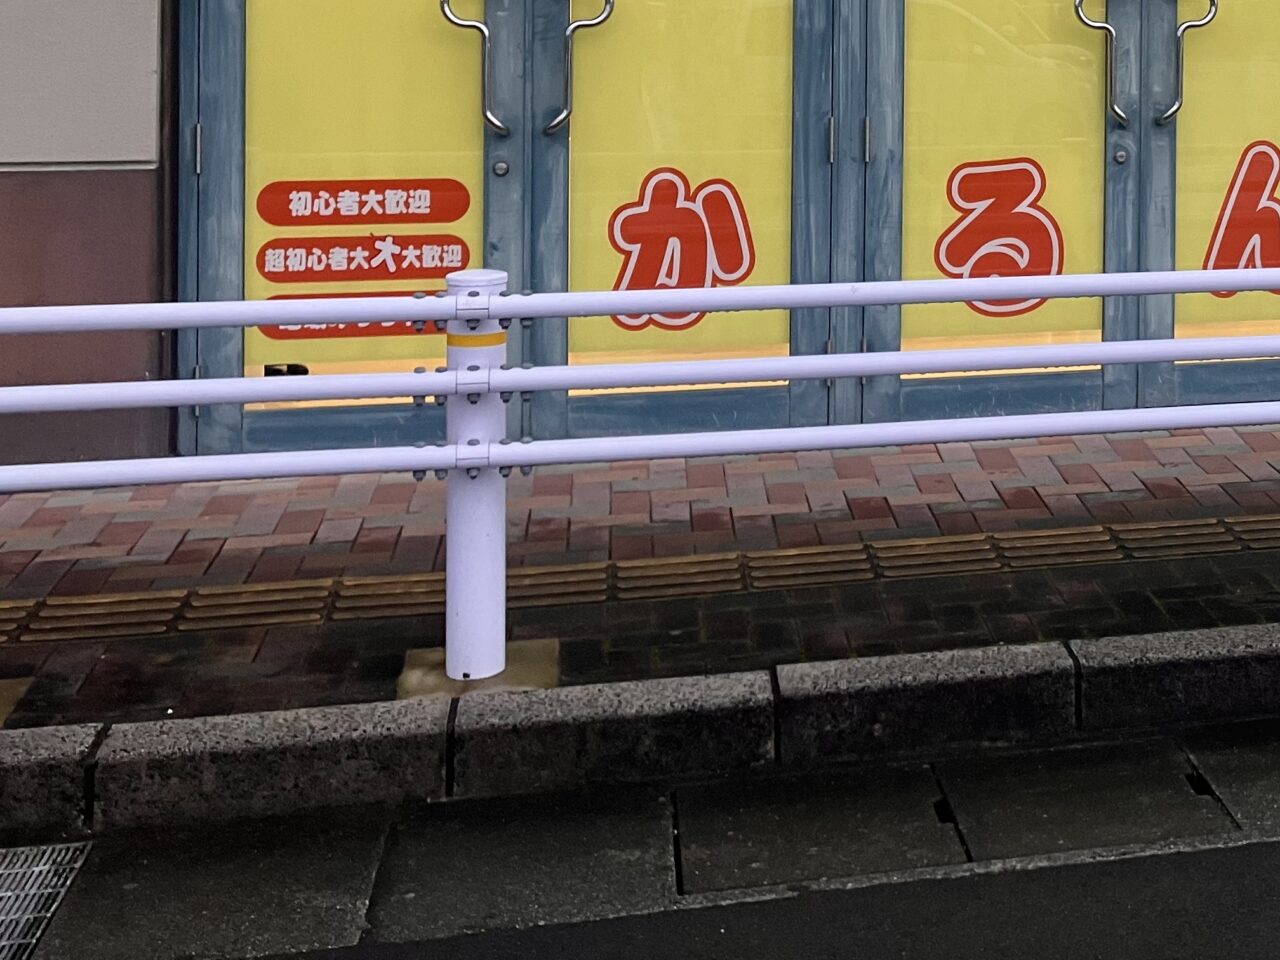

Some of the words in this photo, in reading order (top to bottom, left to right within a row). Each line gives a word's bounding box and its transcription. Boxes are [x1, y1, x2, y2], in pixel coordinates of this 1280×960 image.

[289, 189, 431, 217] 初心者大歓迎
[264, 235, 462, 273] 超初心者大大大歓迎
